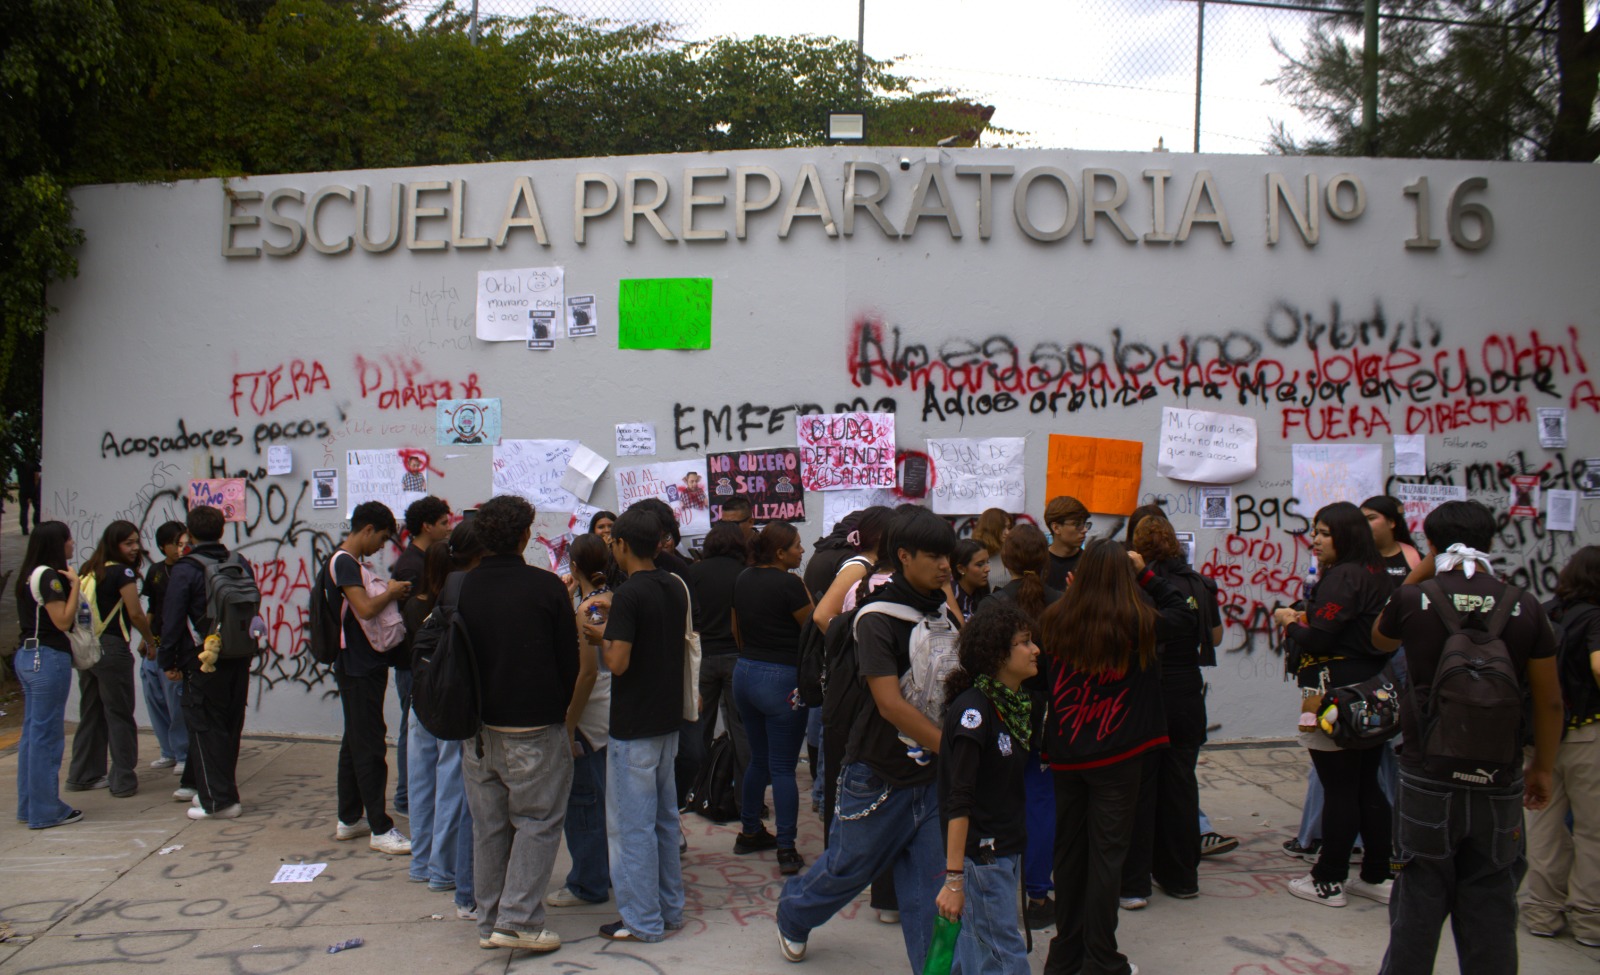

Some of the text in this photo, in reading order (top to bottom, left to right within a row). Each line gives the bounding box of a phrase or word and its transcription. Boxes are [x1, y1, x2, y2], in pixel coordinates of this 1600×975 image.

[221, 176, 550, 257] ESCUELA
[574, 161, 1235, 245] PREPARATORIA
[1403, 176, 1495, 251] 16
[230, 360, 331, 417] FUERA
[1281, 405, 1393, 441] FUERA
[1404, 395, 1532, 436] DIRECTOR
[101, 419, 244, 459] Acosadores
[253, 420, 332, 454] pocos
[709, 453, 797, 474] NO QUIERO
[620, 469, 659, 487] NO AL
[735, 475, 767, 494] SER
[806, 466, 892, 487] ACOSADORES
[191, 481, 211, 497] YA
[623, 480, 667, 500] SILENCIO
